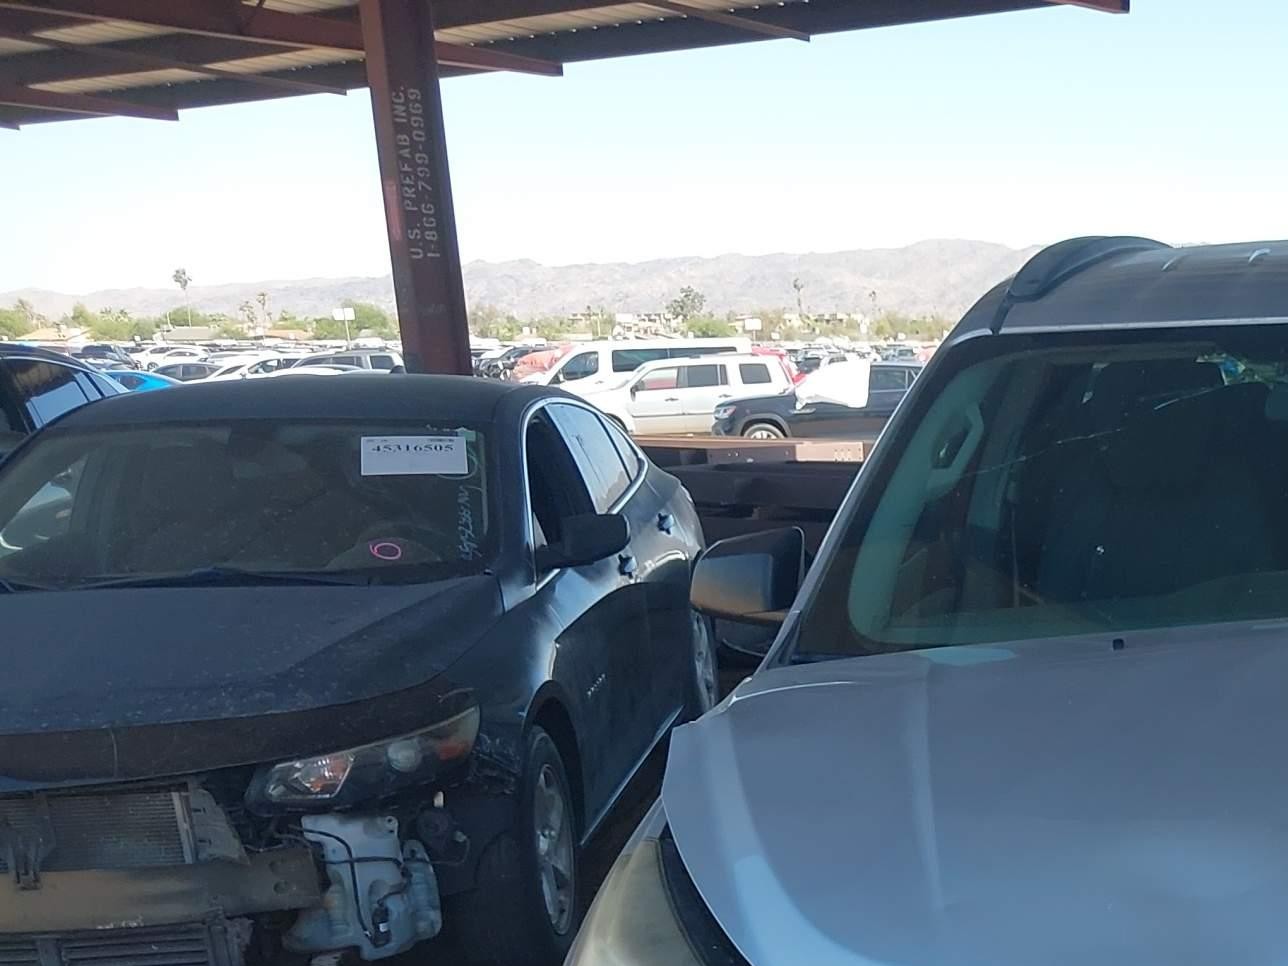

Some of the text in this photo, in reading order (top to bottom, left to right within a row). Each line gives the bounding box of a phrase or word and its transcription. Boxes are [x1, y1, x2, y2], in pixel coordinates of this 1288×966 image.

[392, 86, 424, 260] U.S. PREFAB INC.
[371, 443, 454, 453] 45316505
